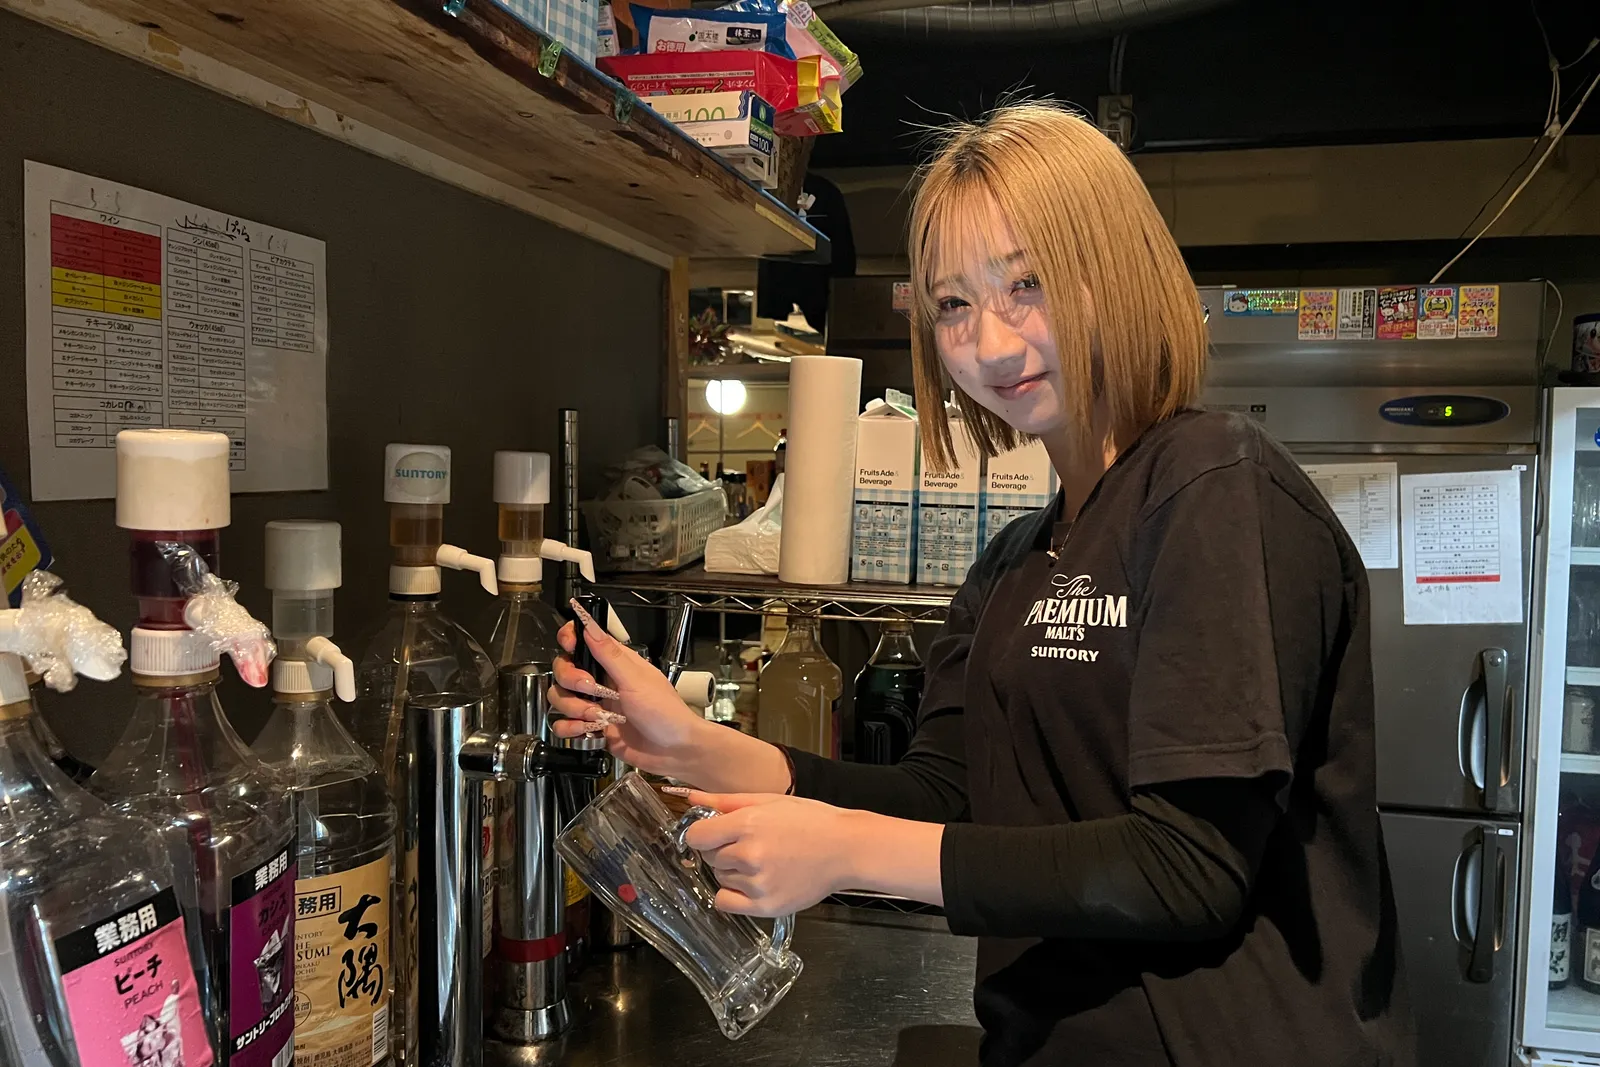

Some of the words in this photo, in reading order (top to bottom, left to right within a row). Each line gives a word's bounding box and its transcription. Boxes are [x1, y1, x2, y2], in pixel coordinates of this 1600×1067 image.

[656, 38, 686, 52] お徳用
[100, 214, 120, 225] ワイン
[1380, 294, 1416, 308] イースマイル
[395, 468, 447, 480] SUNTORY
[859, 477, 892, 486] Beverage
[924, 480, 958, 489] Beverage
[991, 481, 1026, 490] Beverage
[1051, 574, 1096, 598] The
[1044, 625, 1085, 642] MALT'S
[1031, 646, 1099, 662] SUNTORY
[254, 850, 288, 891] 業務用
[298, 892, 336, 916] 務用
[94, 903, 158, 954] 業務用
[296, 941, 311, 950] HE
[297, 946, 330, 962] SUMI
[114, 954, 162, 995] ピーチ
[124, 980, 163, 1008] PEACH
